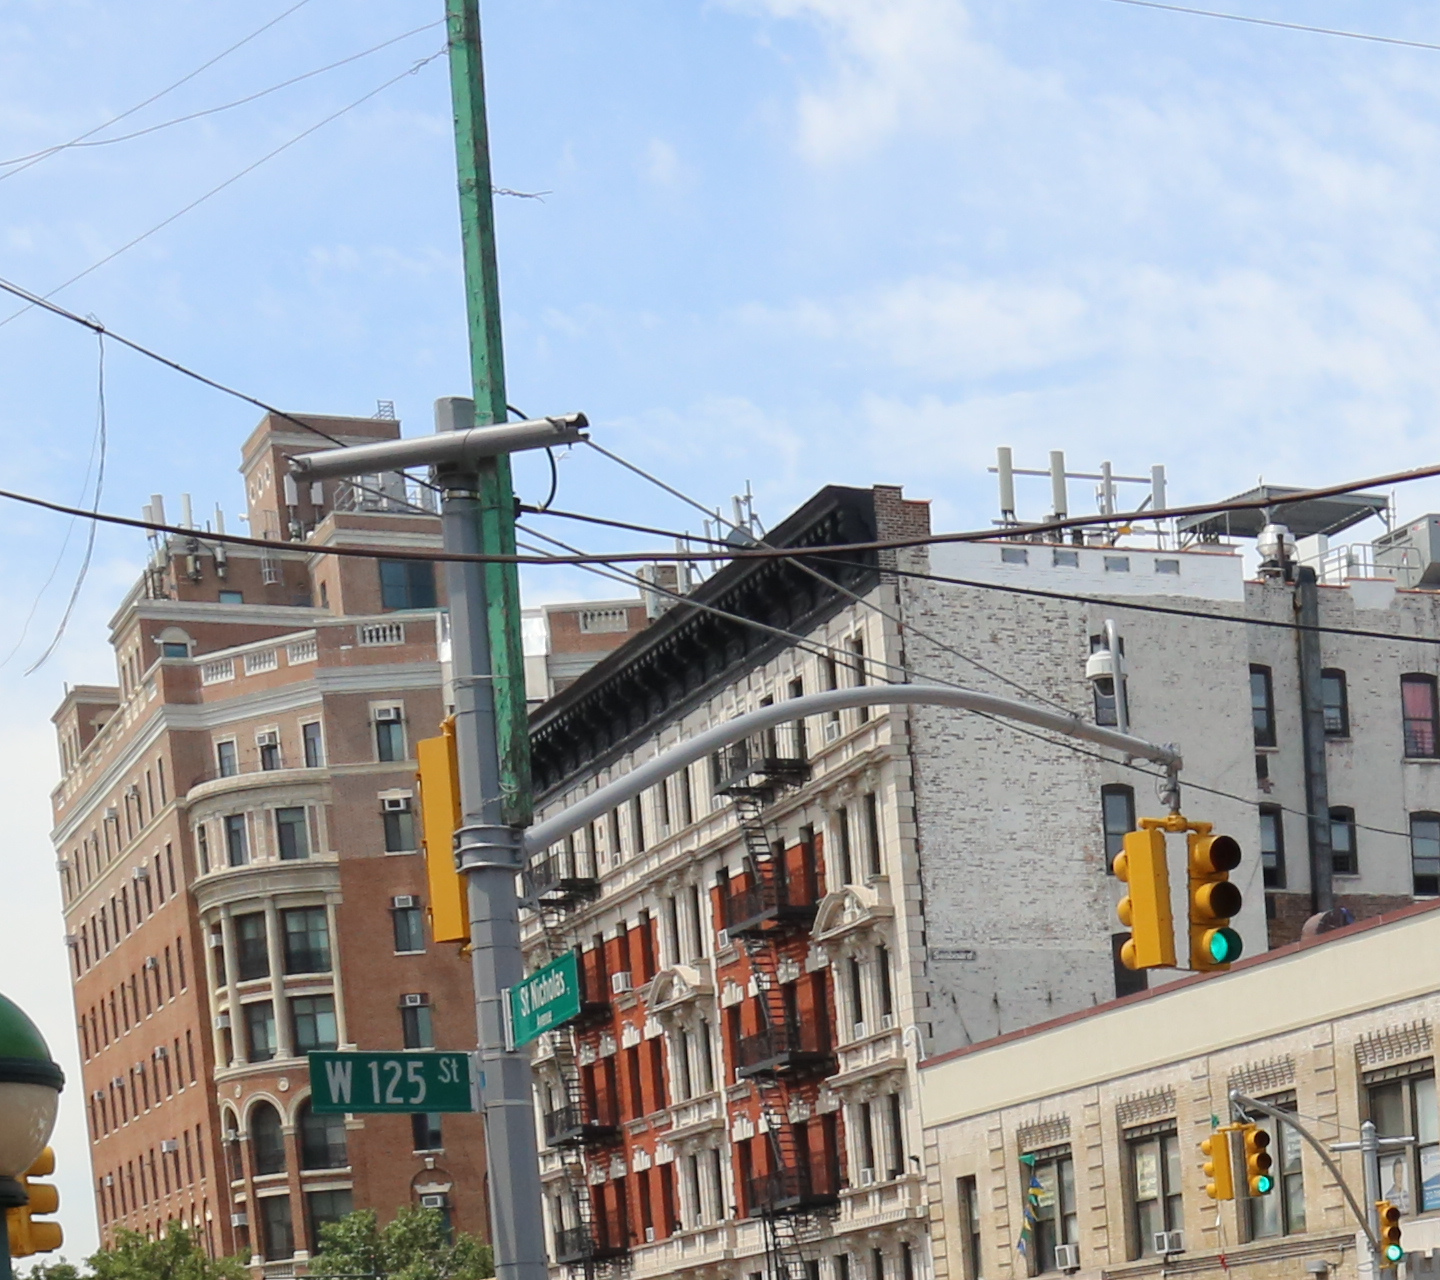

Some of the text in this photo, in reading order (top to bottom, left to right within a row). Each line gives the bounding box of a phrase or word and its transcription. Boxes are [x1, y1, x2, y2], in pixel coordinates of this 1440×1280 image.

[324, 1056, 460, 1104] W 125 St
